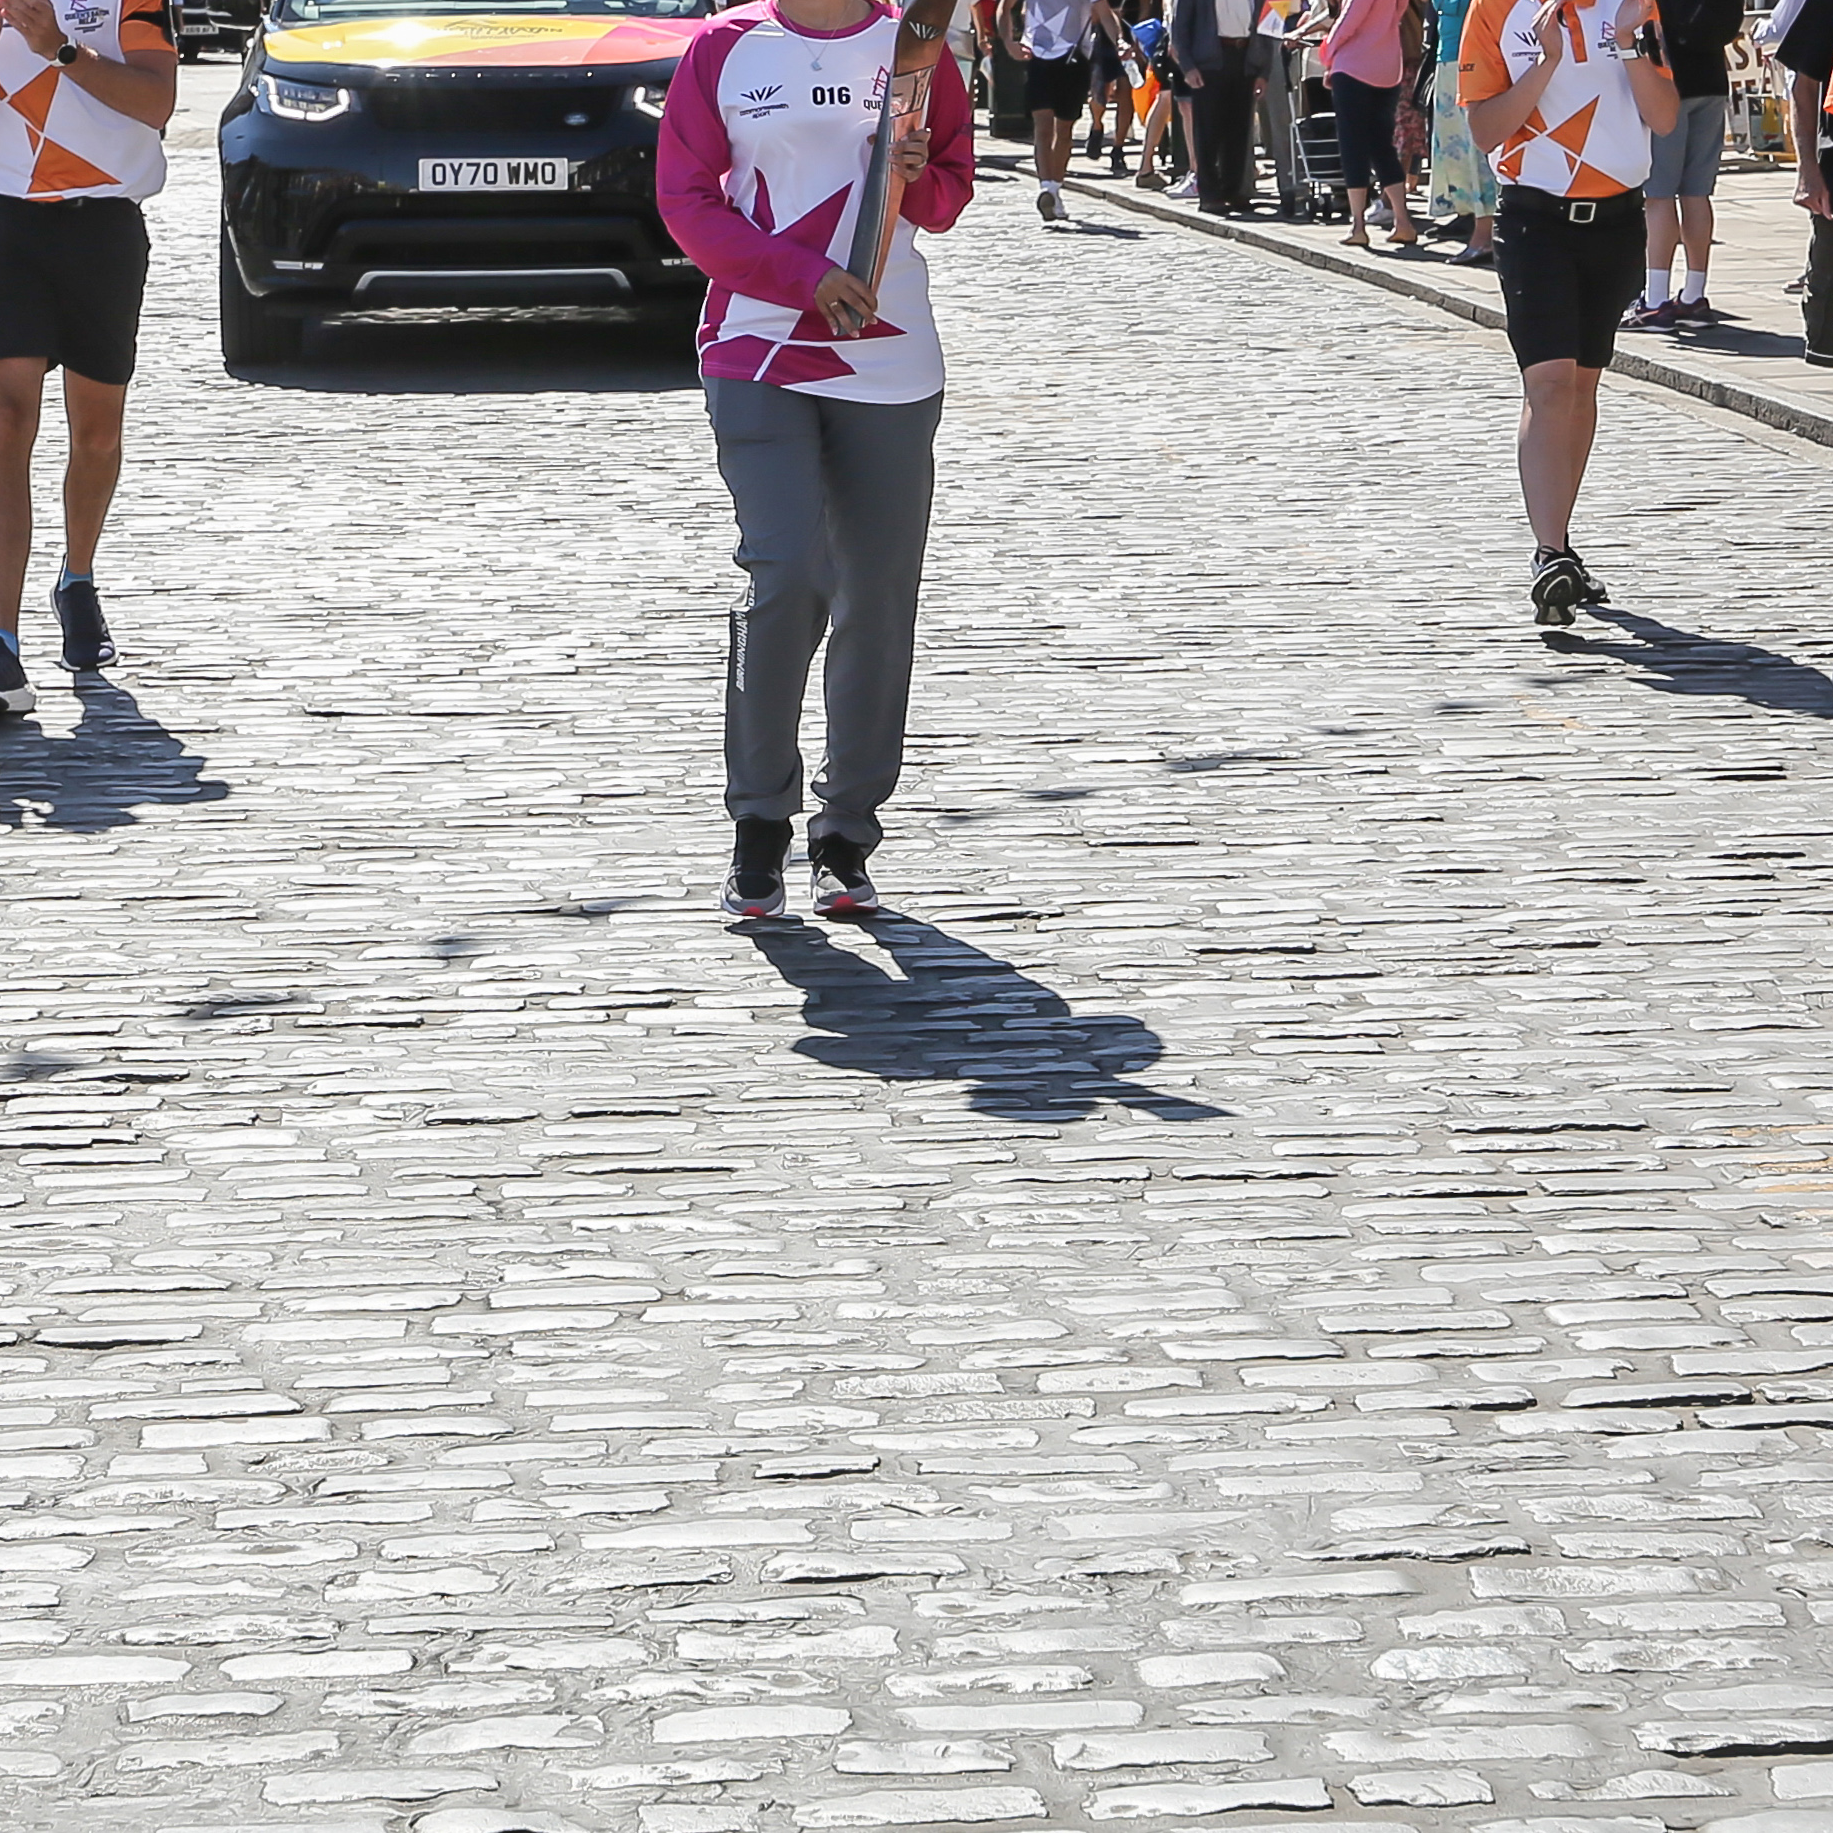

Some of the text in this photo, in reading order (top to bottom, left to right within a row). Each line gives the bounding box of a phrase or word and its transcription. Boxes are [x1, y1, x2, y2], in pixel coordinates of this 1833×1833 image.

[812, 86, 851, 105] 016
[432, 161, 556, 186] OY70 WMO
